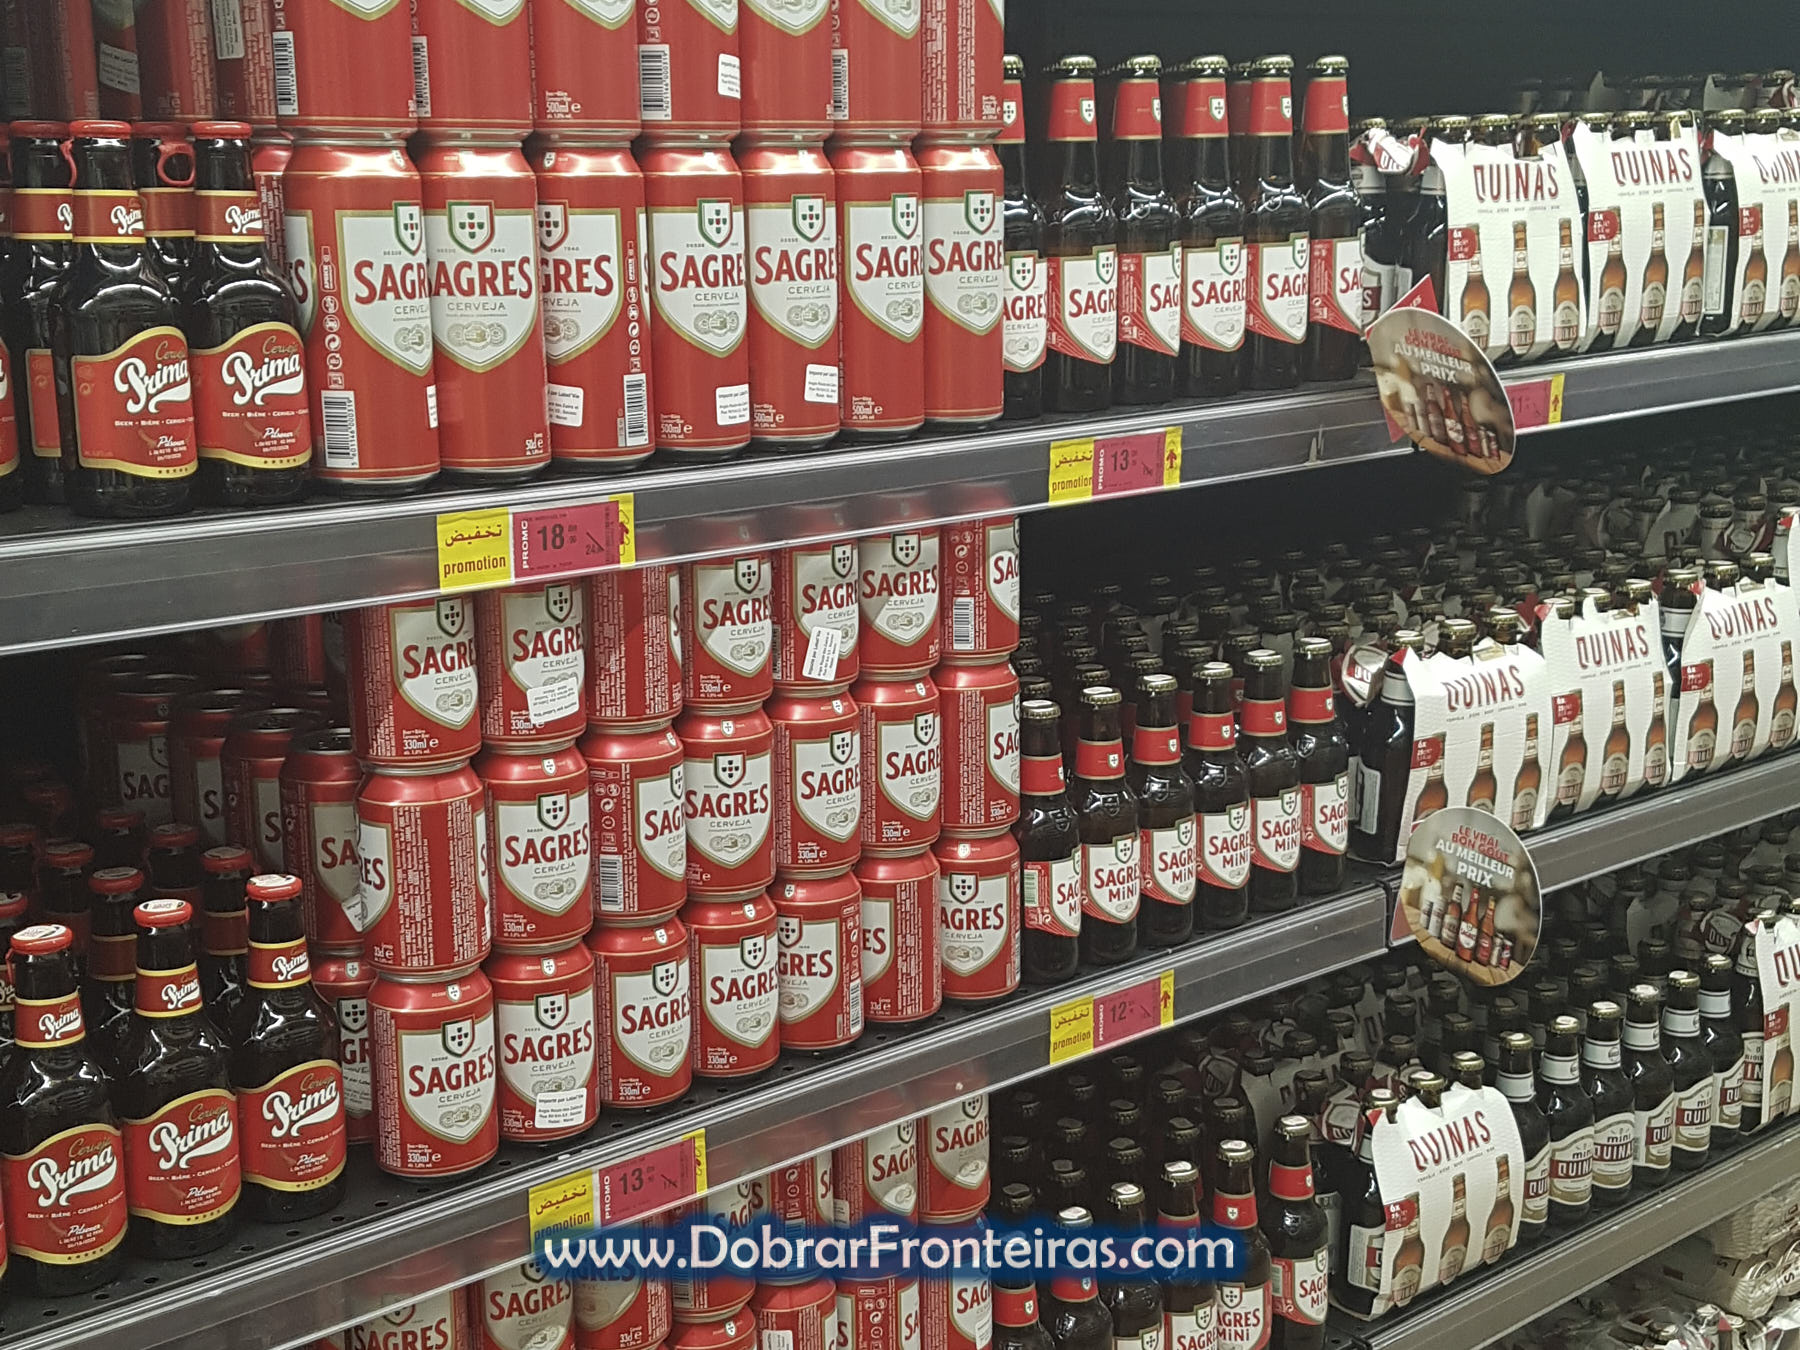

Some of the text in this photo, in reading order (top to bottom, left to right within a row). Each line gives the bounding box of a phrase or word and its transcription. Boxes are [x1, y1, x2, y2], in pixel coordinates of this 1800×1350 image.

[1473, 163, 1559, 203] QUINAS
[1611, 148, 1693, 186] QUINAS
[1752, 150, 1800, 184] QUIN
[660, 251, 746, 293] SAGRE
[754, 245, 837, 286] SAGRE
[928, 238, 1003, 275] SAGRE
[353, 258, 429, 305] SAGR
[431, 255, 533, 299] AGRES
[543, 298, 580, 307] RVEJA
[1068, 287, 1117, 318] SAGR
[222, 351, 304, 405] Prima
[1415, 347, 1472, 374] MEILLEUR
[1420, 362, 1458, 383] PRIX
[114, 357, 191, 413] Prima
[1111, 449, 1130, 472] 13
[445, 523, 502, 547] تخفيض
[537, 523, 565, 551] 18
[443, 555, 506, 578] promotion
[862, 564, 938, 600] SAGRES
[1705, 597, 1778, 641] QUINAS
[1576, 624, 1649, 670] QUINAS
[1442, 663, 1525, 713] QUINAS
[685, 783, 769, 820] SAGRES
[504, 822, 590, 868] SAGRES
[1435, 839, 1515, 879] AU MEILLEUR
[1456, 862, 1494, 888] PRIX
[39, 1007, 82, 1040] Prima
[1110, 1001, 1127, 1023] 12
[503, 1019, 592, 1064] SAGRES
[1052, 1029, 1091, 1053] promotion
[408, 1044, 495, 1097] SAGRES
[262, 1079, 339, 1137] Prima
[149, 1111, 233, 1169] Prima
[1407, 1110, 1492, 1173] QUINAS
[27, 1146, 118, 1207] Prima
[619, 1167, 644, 1195] 13
[536, 1184, 587, 1215] تخفيض
[603, 1175, 611, 1219] PROMO
[534, 1210, 590, 1240] promotion
